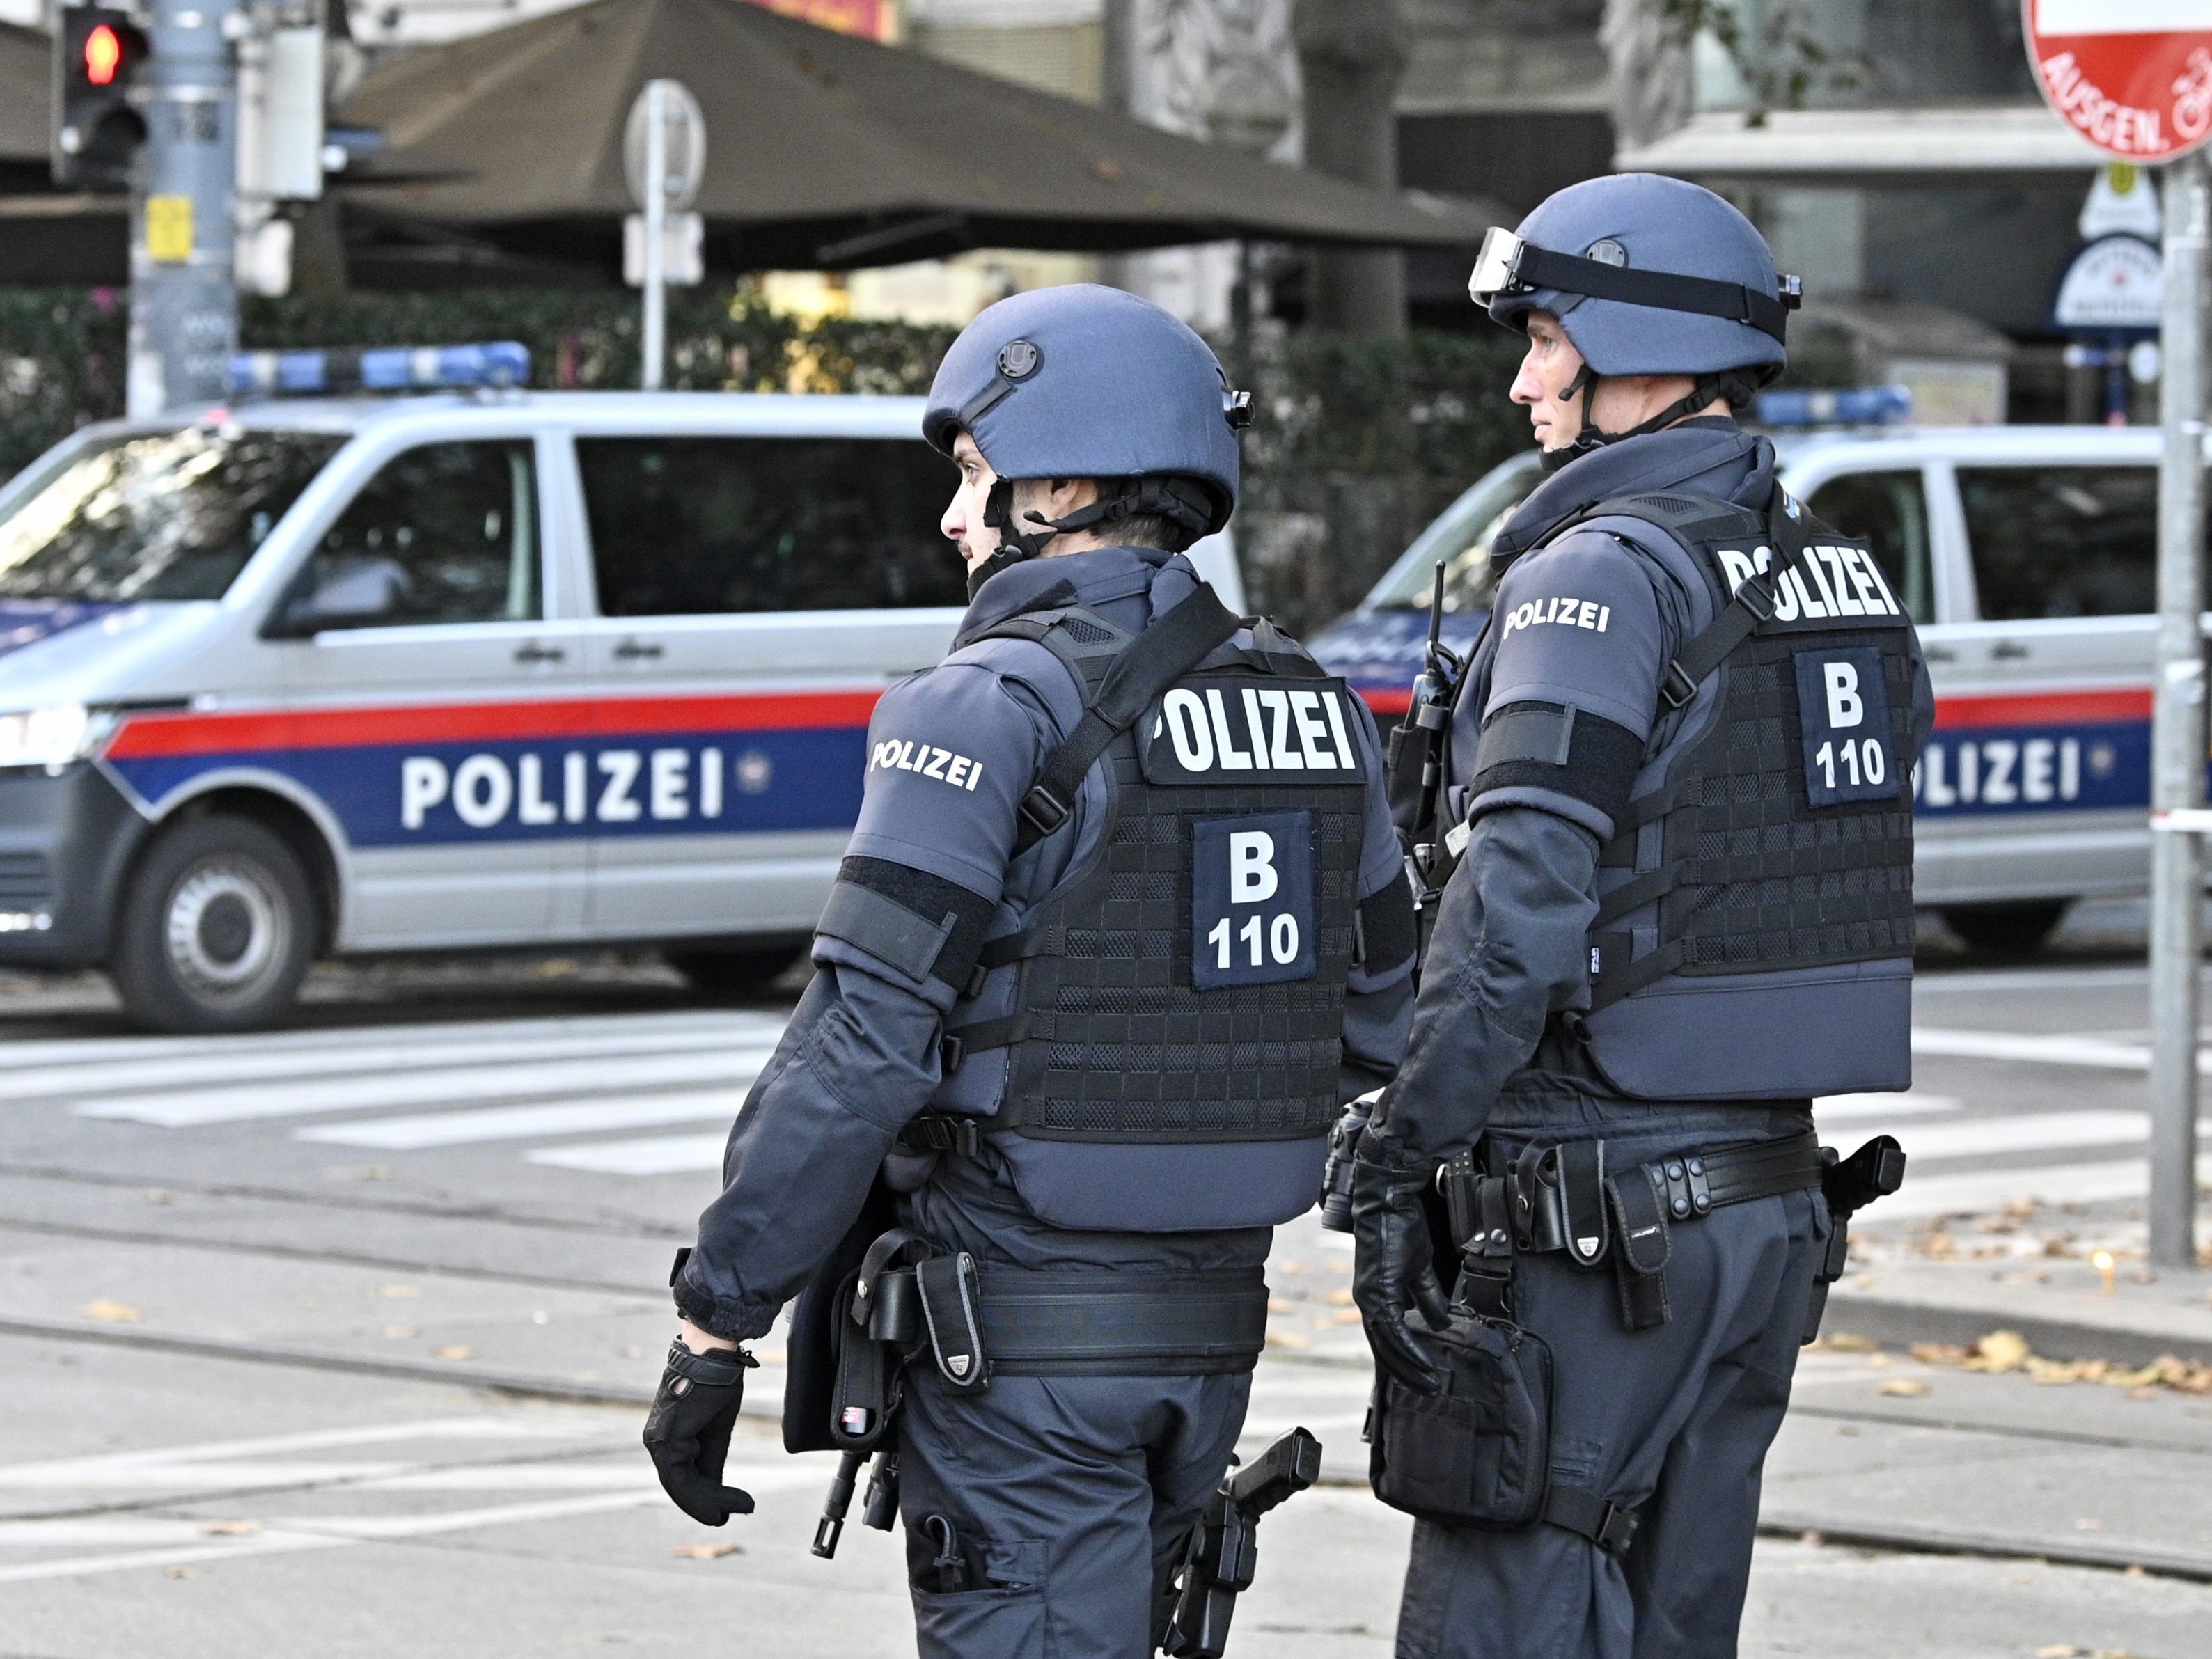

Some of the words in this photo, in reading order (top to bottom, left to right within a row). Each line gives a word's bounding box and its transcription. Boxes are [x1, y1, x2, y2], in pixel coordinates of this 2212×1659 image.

[2041, 51, 2170, 152] AUSGEN.
[1503, 597, 1610, 640] POLIZEI
[1823, 662, 1863, 728] B
[1154, 689, 1356, 772] OLIZEI
[1816, 739, 1885, 788] 110
[402, 747, 723, 829] POLIZEI
[870, 739, 983, 792] POLIZEI
[1913, 738, 2081, 807] LIZEI
[1230, 831, 1278, 904] B
[1208, 913, 1299, 968] 110
